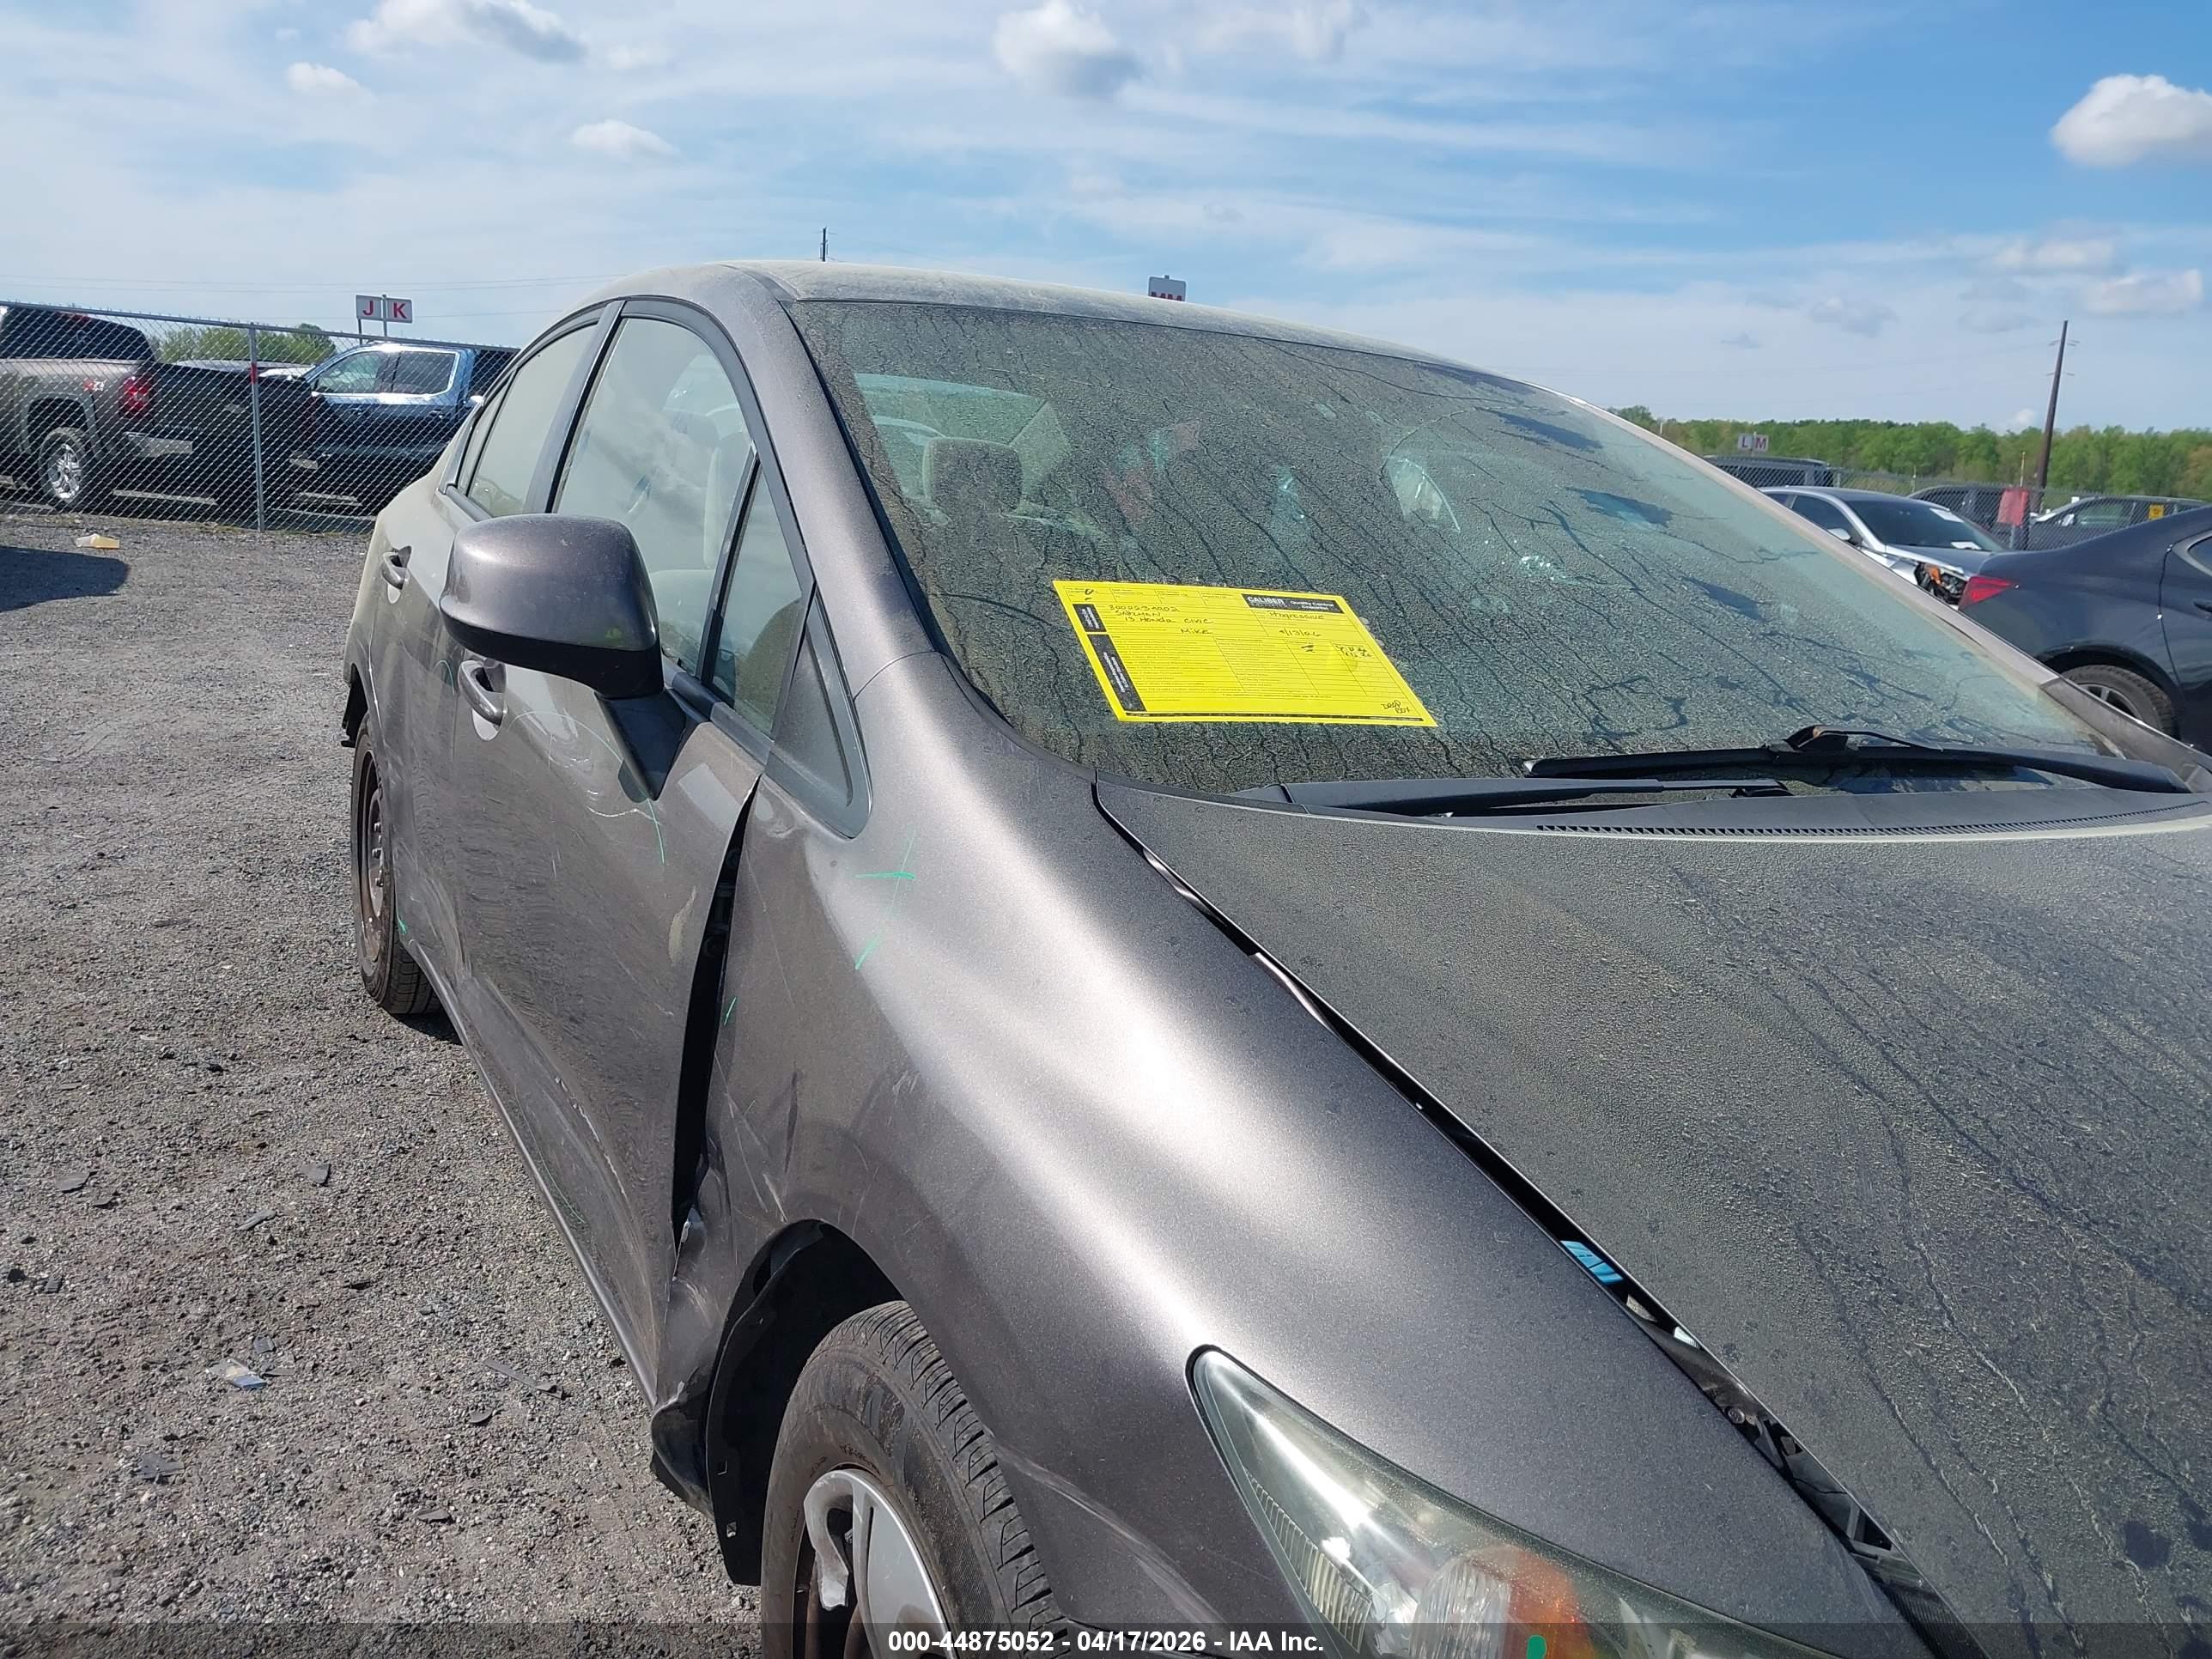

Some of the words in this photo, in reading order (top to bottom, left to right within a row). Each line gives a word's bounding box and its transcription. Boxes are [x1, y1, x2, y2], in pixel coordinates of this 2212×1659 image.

[362, 300, 374, 316] J
[393, 301, 407, 319] K
[1755, 436, 1766, 448] M
[1247, 596, 1285, 605] CALIBER
